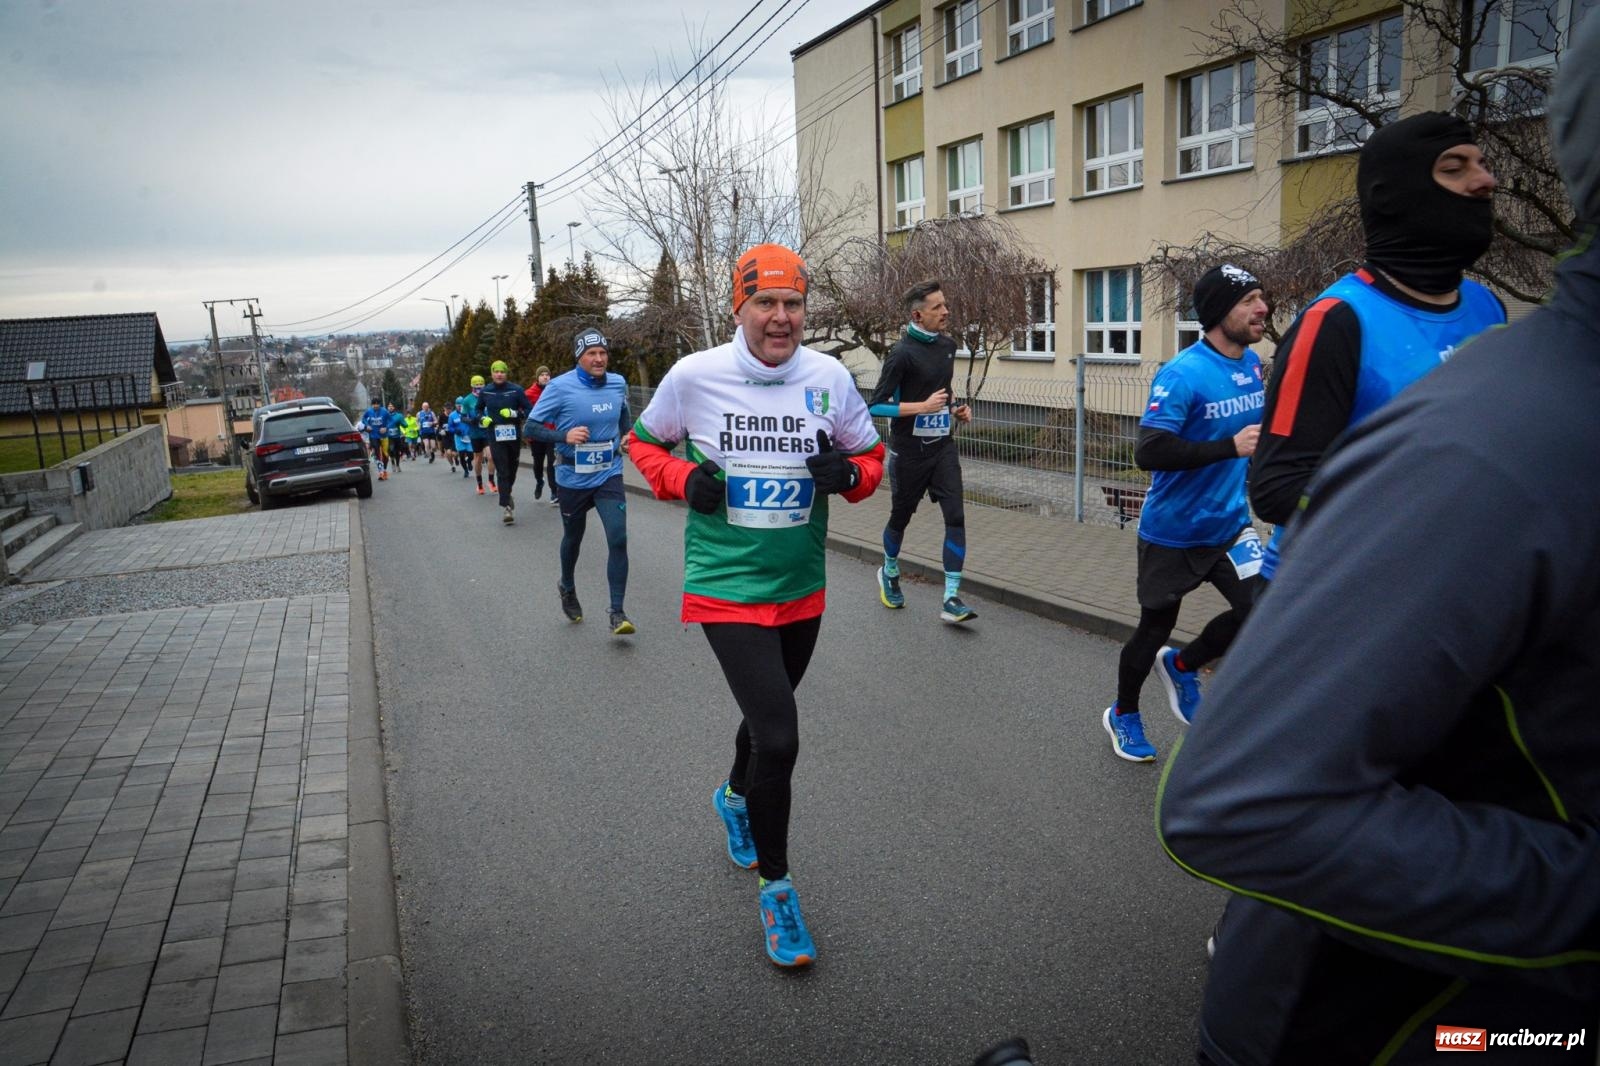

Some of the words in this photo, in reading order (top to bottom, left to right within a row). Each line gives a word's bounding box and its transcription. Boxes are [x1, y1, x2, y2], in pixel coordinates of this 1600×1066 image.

[592, 402, 613, 414] RUN
[1203, 391, 1265, 420] RUNNE
[922, 415, 946, 428] 141
[586, 452, 604, 465] 45
[742, 479, 801, 508] 122
